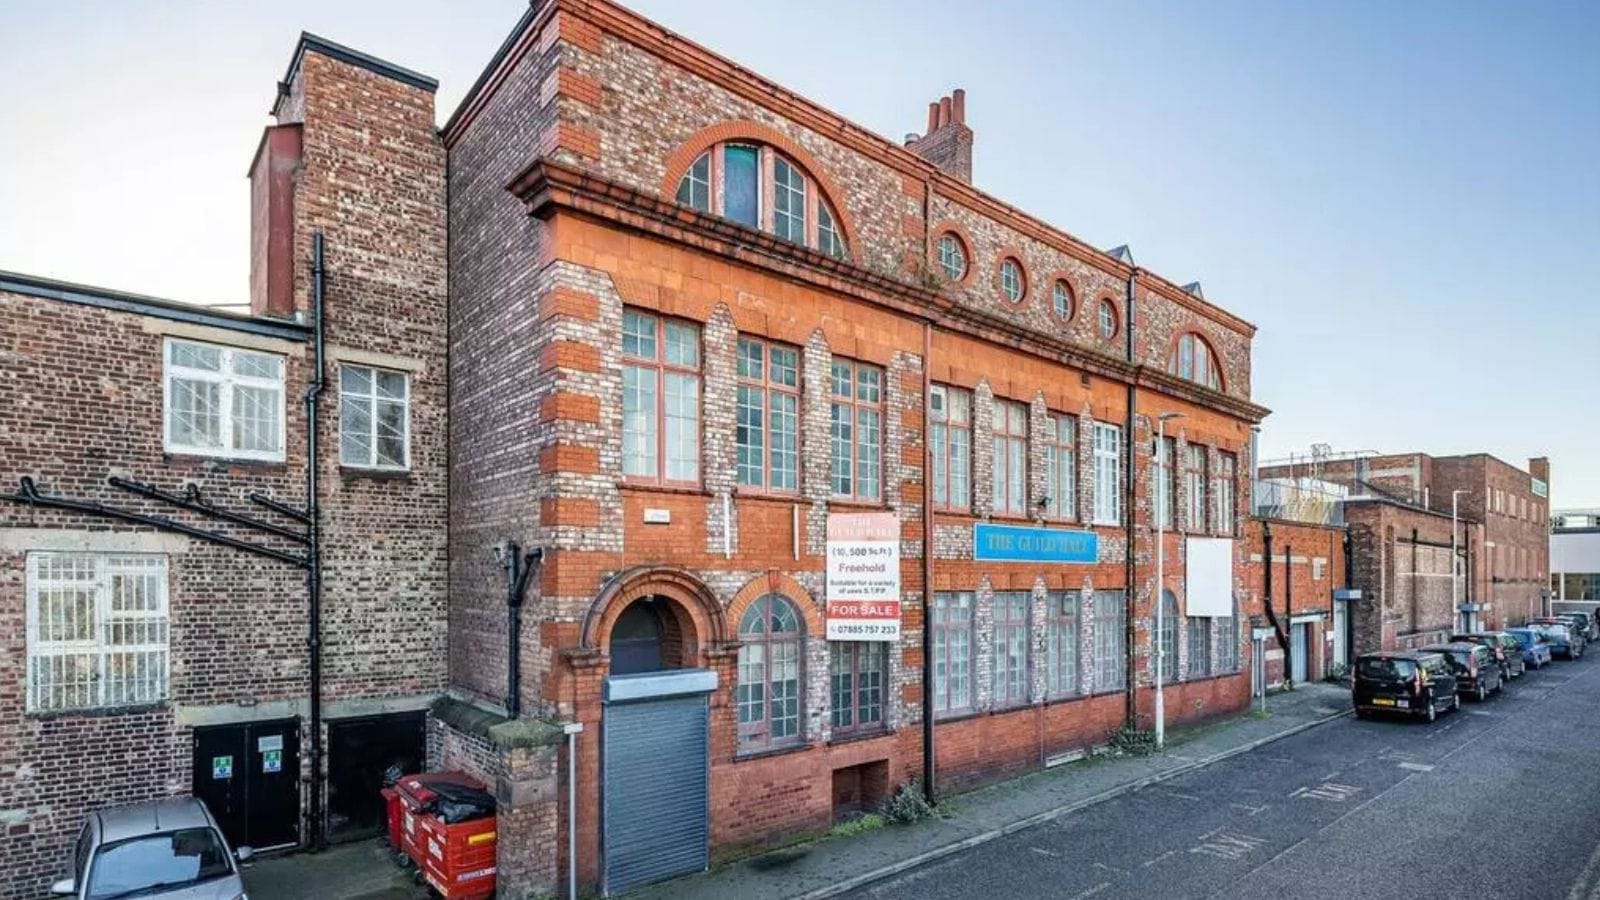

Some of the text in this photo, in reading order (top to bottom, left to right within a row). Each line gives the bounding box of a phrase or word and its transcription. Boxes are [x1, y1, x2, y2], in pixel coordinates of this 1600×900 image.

[987, 534, 1013, 550] THE
[838, 563, 886, 573] Freehold
[874, 580, 896, 588] variety
[831, 605, 894, 615] FOR SALE
